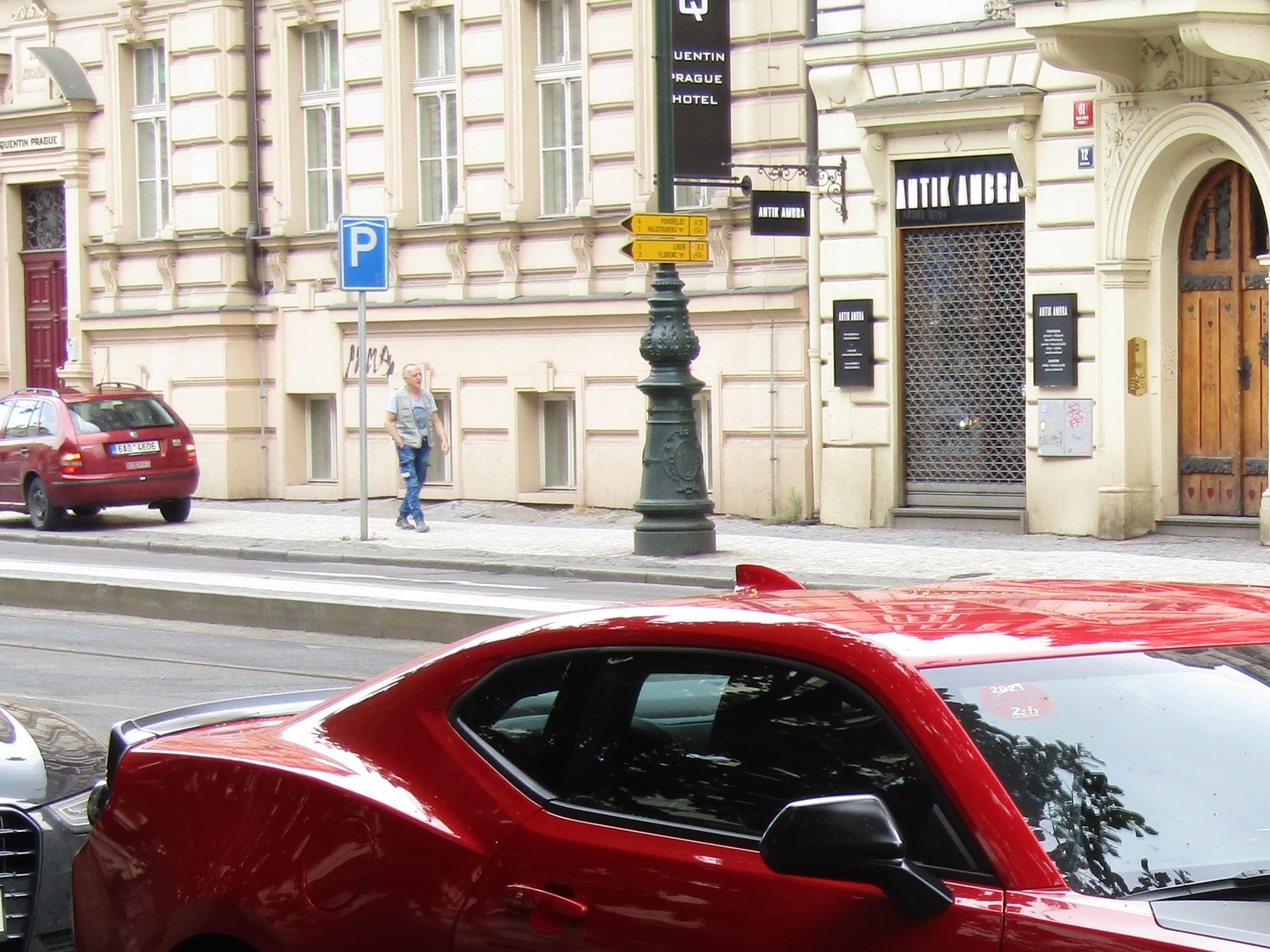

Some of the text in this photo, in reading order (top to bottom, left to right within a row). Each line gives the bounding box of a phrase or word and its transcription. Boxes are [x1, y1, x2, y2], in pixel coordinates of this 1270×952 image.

[673, 51, 725, 62] UENTIN
[672, 94, 718, 105] HOTEL
[0, 136, 58, 150] QUENTIN PRAGUE
[1081, 148, 1089, 161] 12
[895, 171, 1020, 210] ANTIK AMBRA
[758, 206, 806, 219] ANTIK AMBRA
[350, 226, 378, 268] P
[137, 442, 156, 451] 4606
